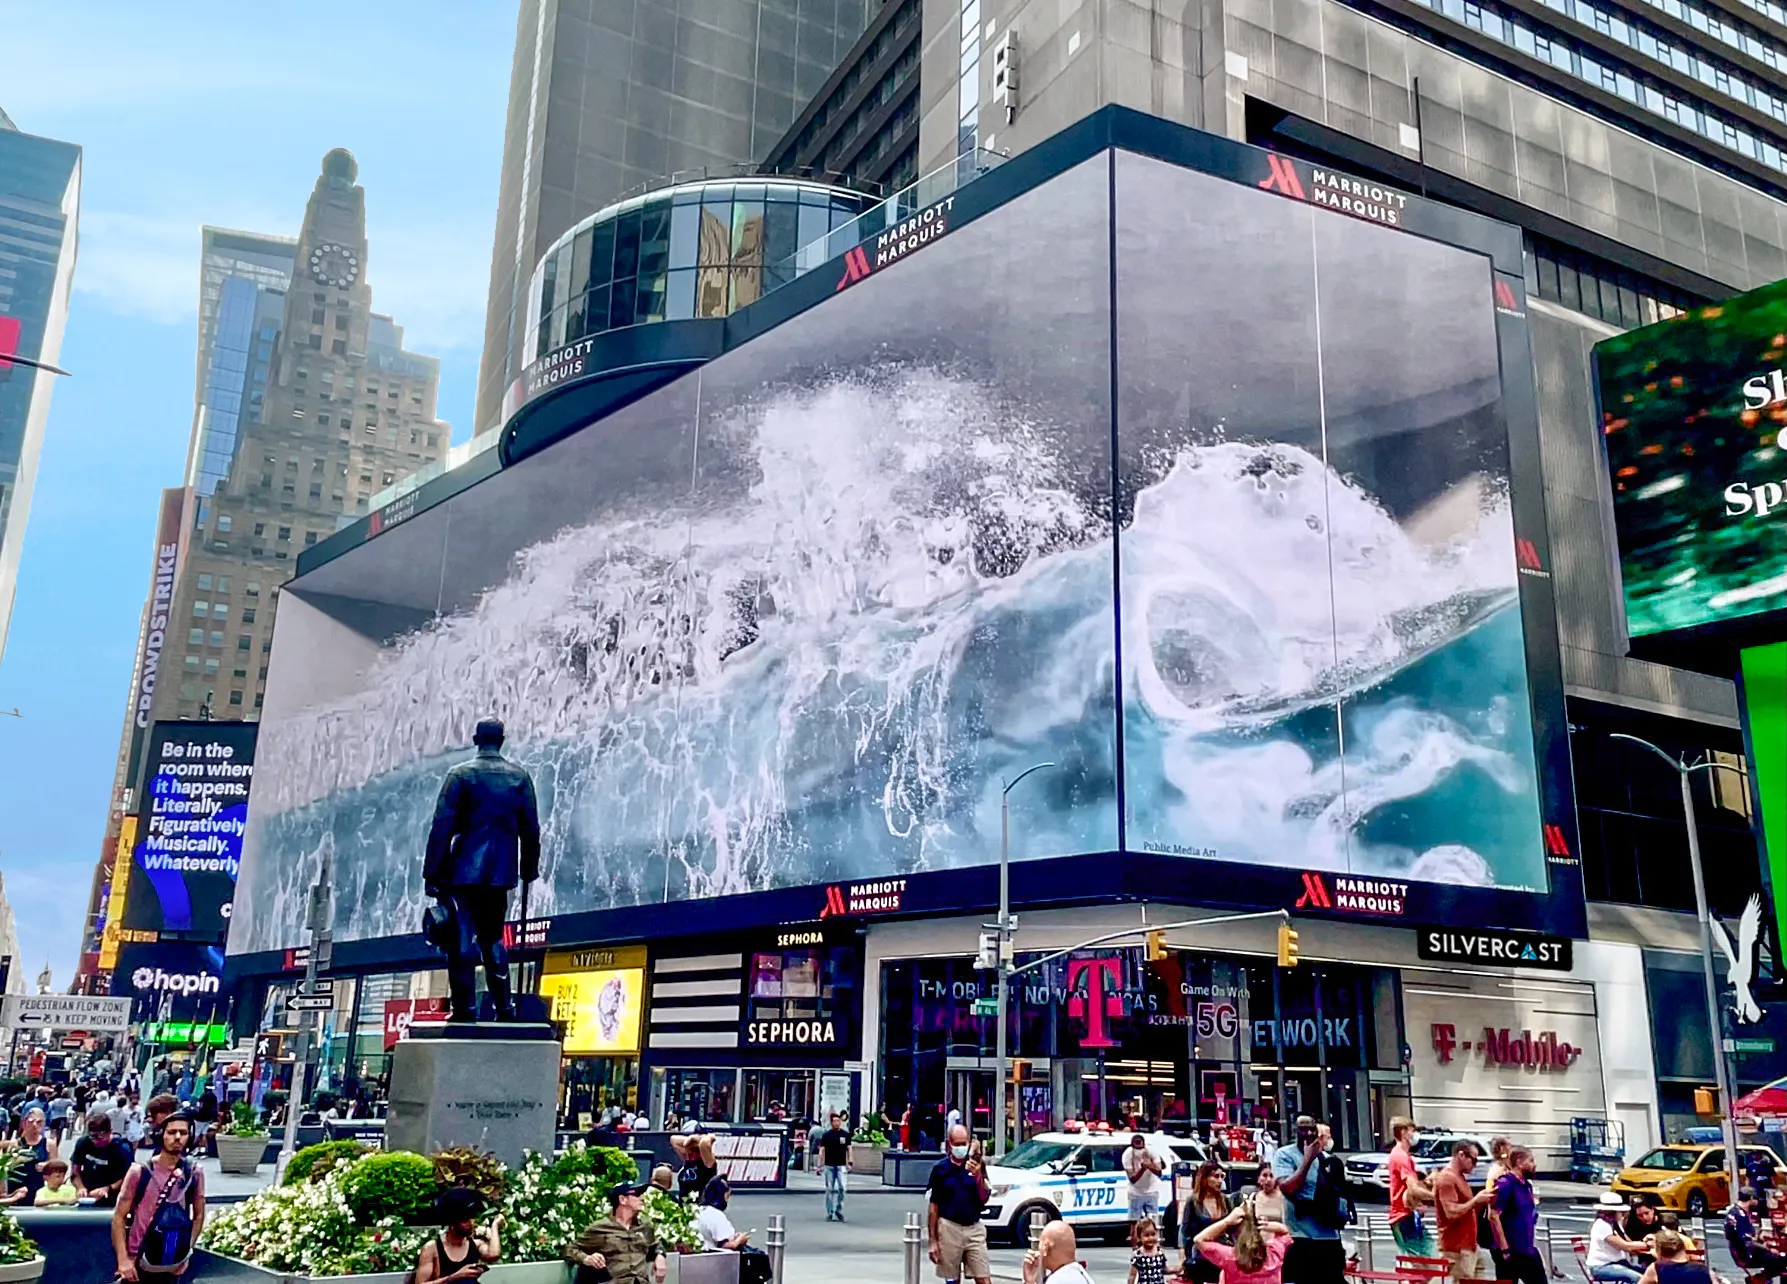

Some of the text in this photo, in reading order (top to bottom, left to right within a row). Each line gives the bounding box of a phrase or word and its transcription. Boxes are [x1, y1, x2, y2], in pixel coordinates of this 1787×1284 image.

[1313, 169, 1407, 209] MARRIOTT
[1314, 188, 1397, 224] MARQUIS
[877, 196, 955, 249] MARRIOTT
[877, 220, 945, 266] MARQUIS
[529, 340, 594, 378] MARRIOTT
[527, 360, 583, 395] MARQUIS
[137, 543, 176, 729] CROWDSTRIKE
[161, 742, 234, 758] Be in the
[158, 763, 203, 776] room
[155, 779, 248, 798] it happens.
[152, 797, 223, 816] Literally.
[149, 816, 245, 837] Figuratively
[146, 835, 229, 855] Musically.
[1143, 841, 1217, 857] Public Media Art
[144, 854, 239, 875] Whateverly
[850, 880, 906, 896] MARRIOTT
[1336, 878, 1408, 897] MARRIOTT
[849, 896, 899, 911] MARQUIS
[1337, 895, 1401, 912] MARQUIS
[515, 932, 546, 944] MRQUIS
[777, 932, 824, 946] SEPHORA
[1429, 932, 1562, 961] SILVERCAST
[154, 968, 220, 996] hopin
[1180, 982, 1210, 996] Game
[19, 999, 124, 1012] PEDESTRIAN FLOW ZONE
[64, 1015, 123, 1026] KEEP MOVING
[1196, 1002, 1238, 1039] 5G
[748, 1021, 835, 1043] SEPHORA
[1249, 1018, 1351, 1047] ETWORK
[1073, 1187, 1116, 1207] NYPD
